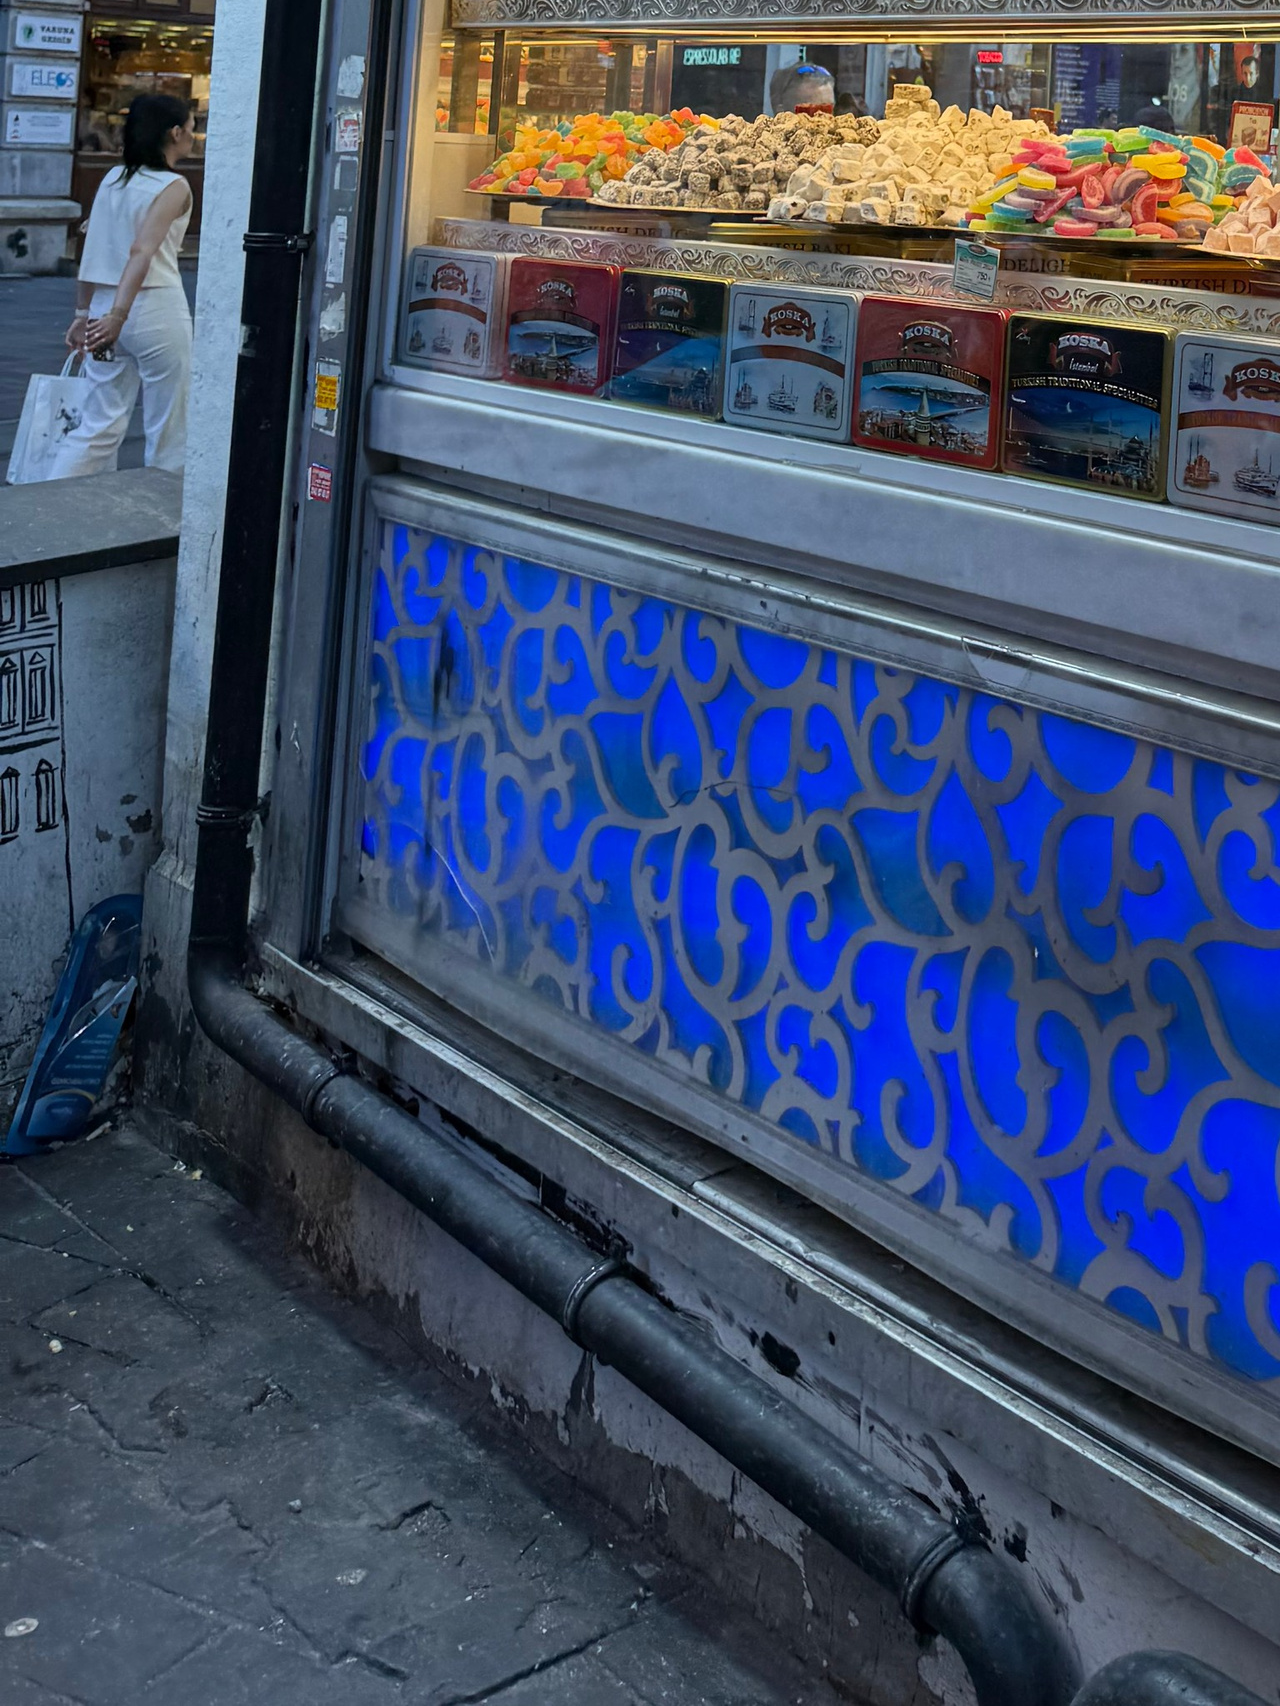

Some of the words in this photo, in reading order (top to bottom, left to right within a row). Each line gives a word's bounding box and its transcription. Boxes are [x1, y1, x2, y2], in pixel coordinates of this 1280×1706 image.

[654, 286, 689, 302] KOSKA
[770, 311, 809, 327] KOSKA
[905, 326, 950, 345] KOSKA
[1058, 334, 1112, 355] KOSKA
[1011, 377, 1046, 388] TURKISH
[1049, 377, 1101, 392] TRADITIONAL
